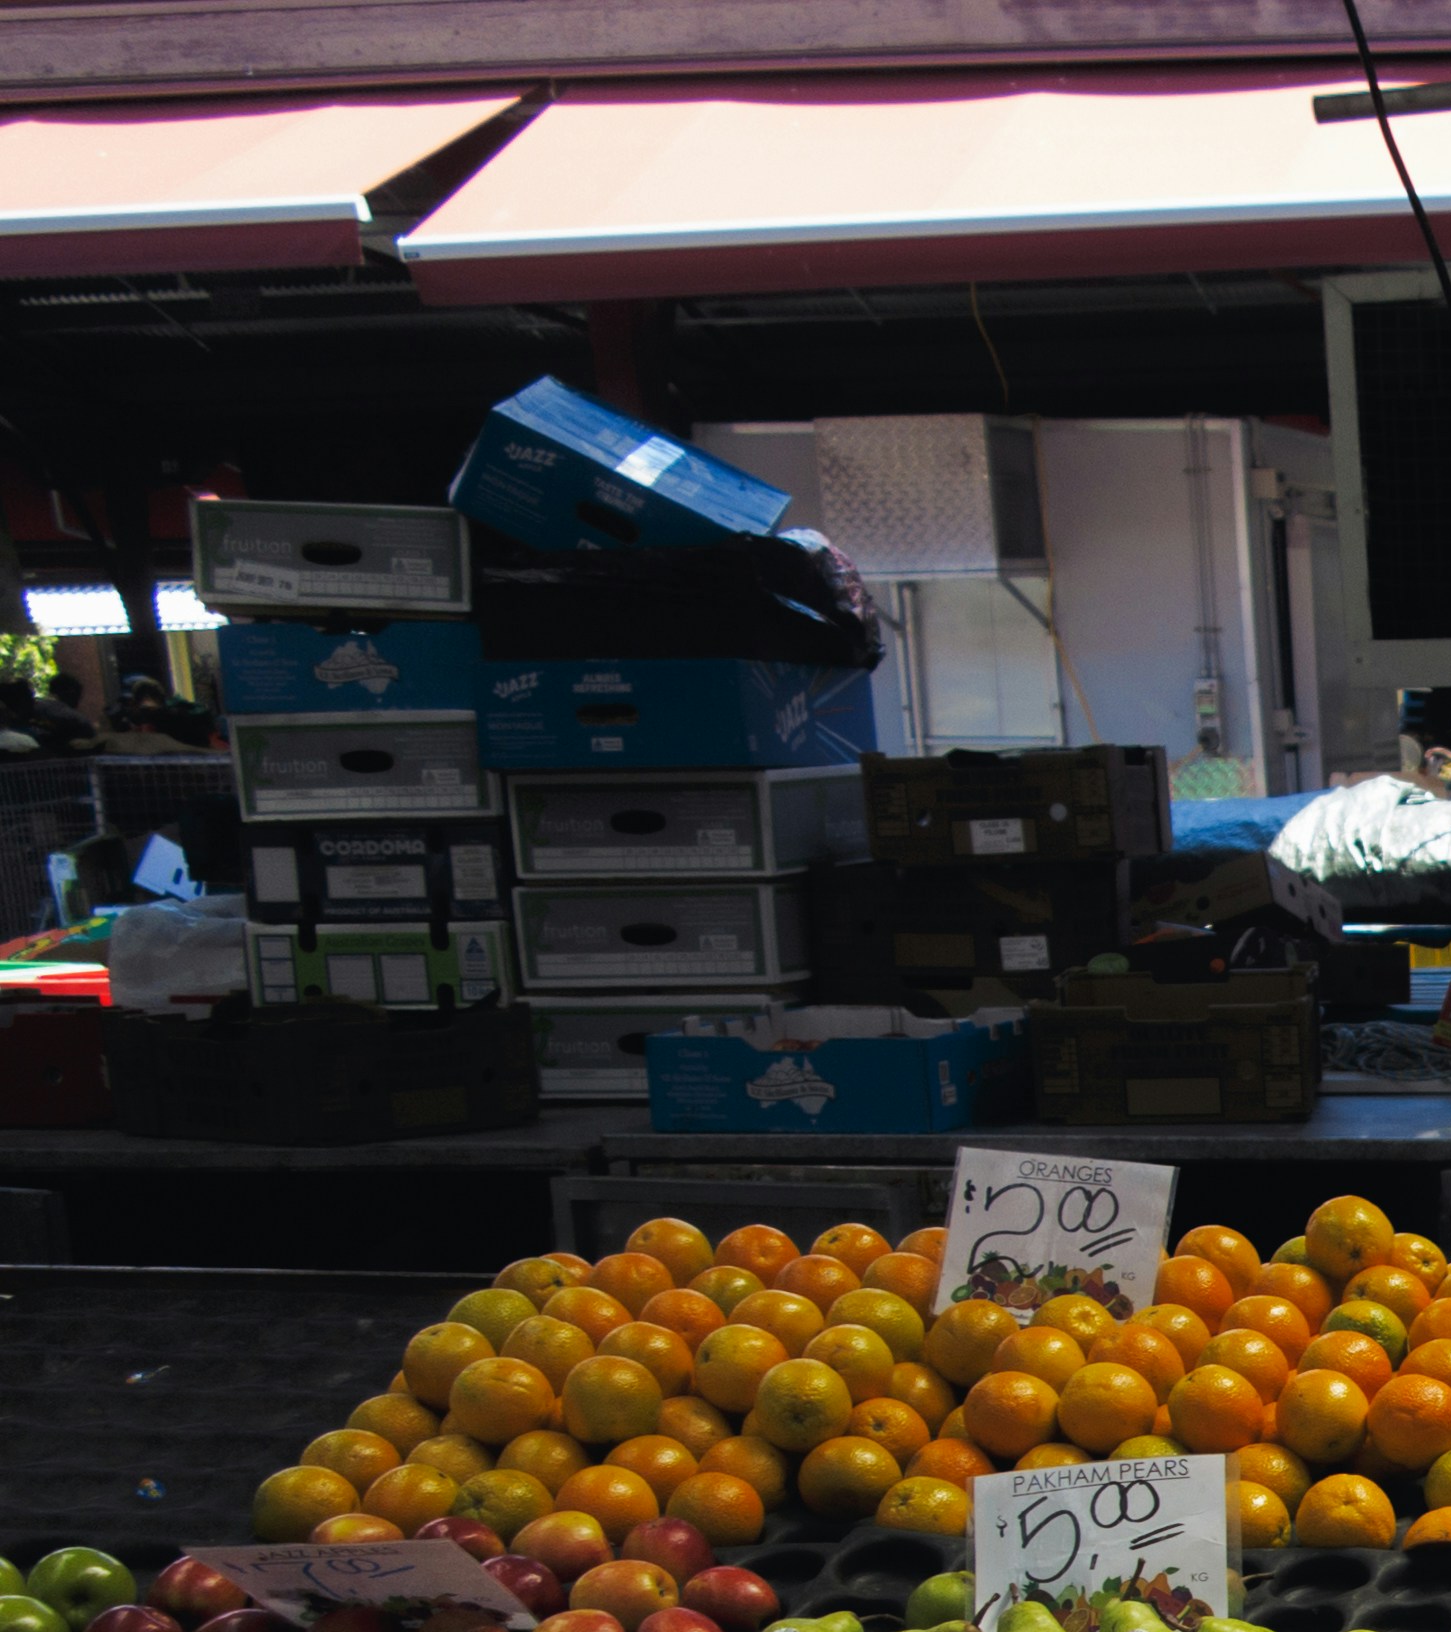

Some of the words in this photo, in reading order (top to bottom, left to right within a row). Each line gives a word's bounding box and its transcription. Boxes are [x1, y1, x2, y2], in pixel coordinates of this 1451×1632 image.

[223, 534, 291, 553] fruition
[501, 671, 539, 699] JAZZ
[262, 758, 328, 775] fruition
[540, 817, 605, 833] fruition
[320, 839, 427, 856] CORDOMA
[543, 923, 607, 938] fruition
[548, 1040, 611, 1054] fruition
[1018, 1160, 1113, 1183] ORANGES
[1121, 1271, 1136, 1281] KG
[1013, 1466, 1112, 1494] PAKHAM
[1119, 1458, 1190, 1479] PEARS
[1191, 1573, 1209, 1583] KG
